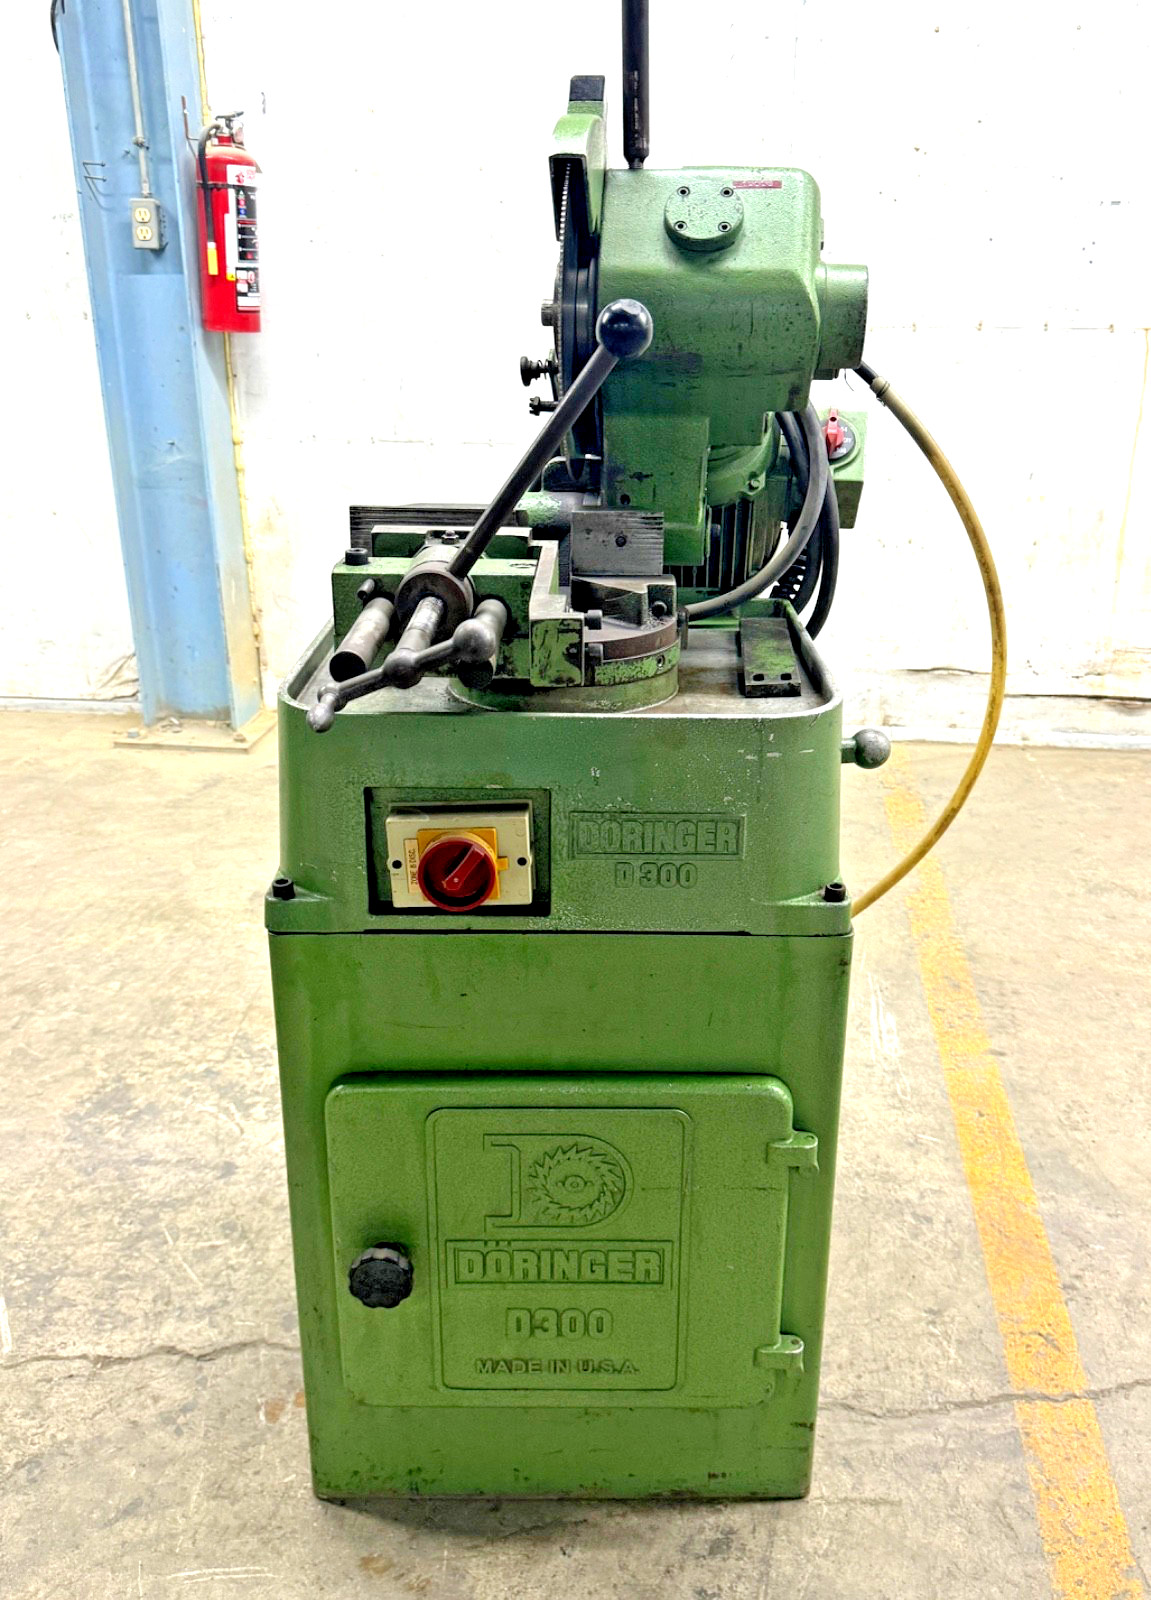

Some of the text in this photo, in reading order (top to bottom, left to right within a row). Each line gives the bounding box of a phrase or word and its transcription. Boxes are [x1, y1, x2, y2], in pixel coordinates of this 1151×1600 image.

[457, 1241, 662, 1282] DÖRINGER
[505, 1307, 614, 1340] D300
[476, 1358, 640, 1375] MADE IN U.S.A.
